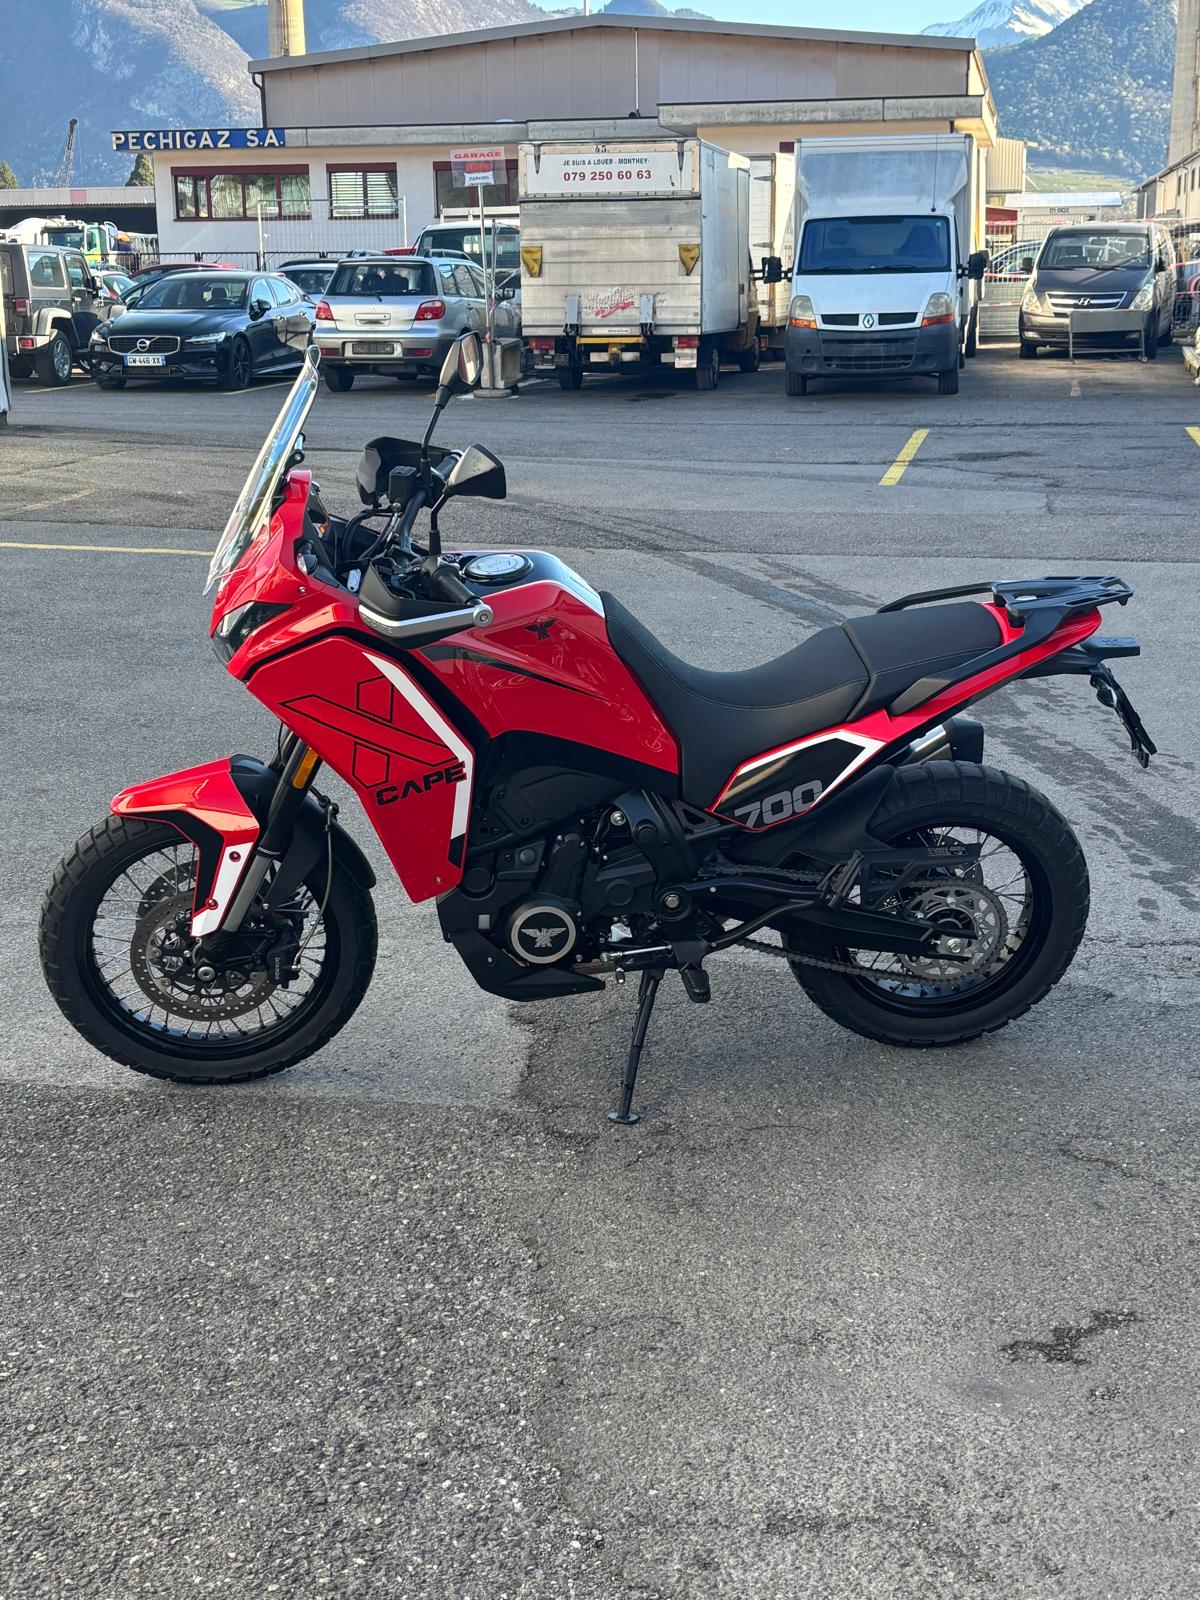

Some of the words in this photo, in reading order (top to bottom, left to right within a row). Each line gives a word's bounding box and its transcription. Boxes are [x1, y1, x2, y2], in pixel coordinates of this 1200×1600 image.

[111, 130, 231, 150] PECHIGAZ
[246, 129, 284, 147] S.A.
[454, 151, 502, 159] GARAGE
[563, 171, 586, 181] 079
[590, 170, 613, 181] 250
[617, 170, 632, 180] 60
[636, 169, 652, 180] 63
[376, 761, 467, 806] CAPE
[734, 779, 823, 829] 700
